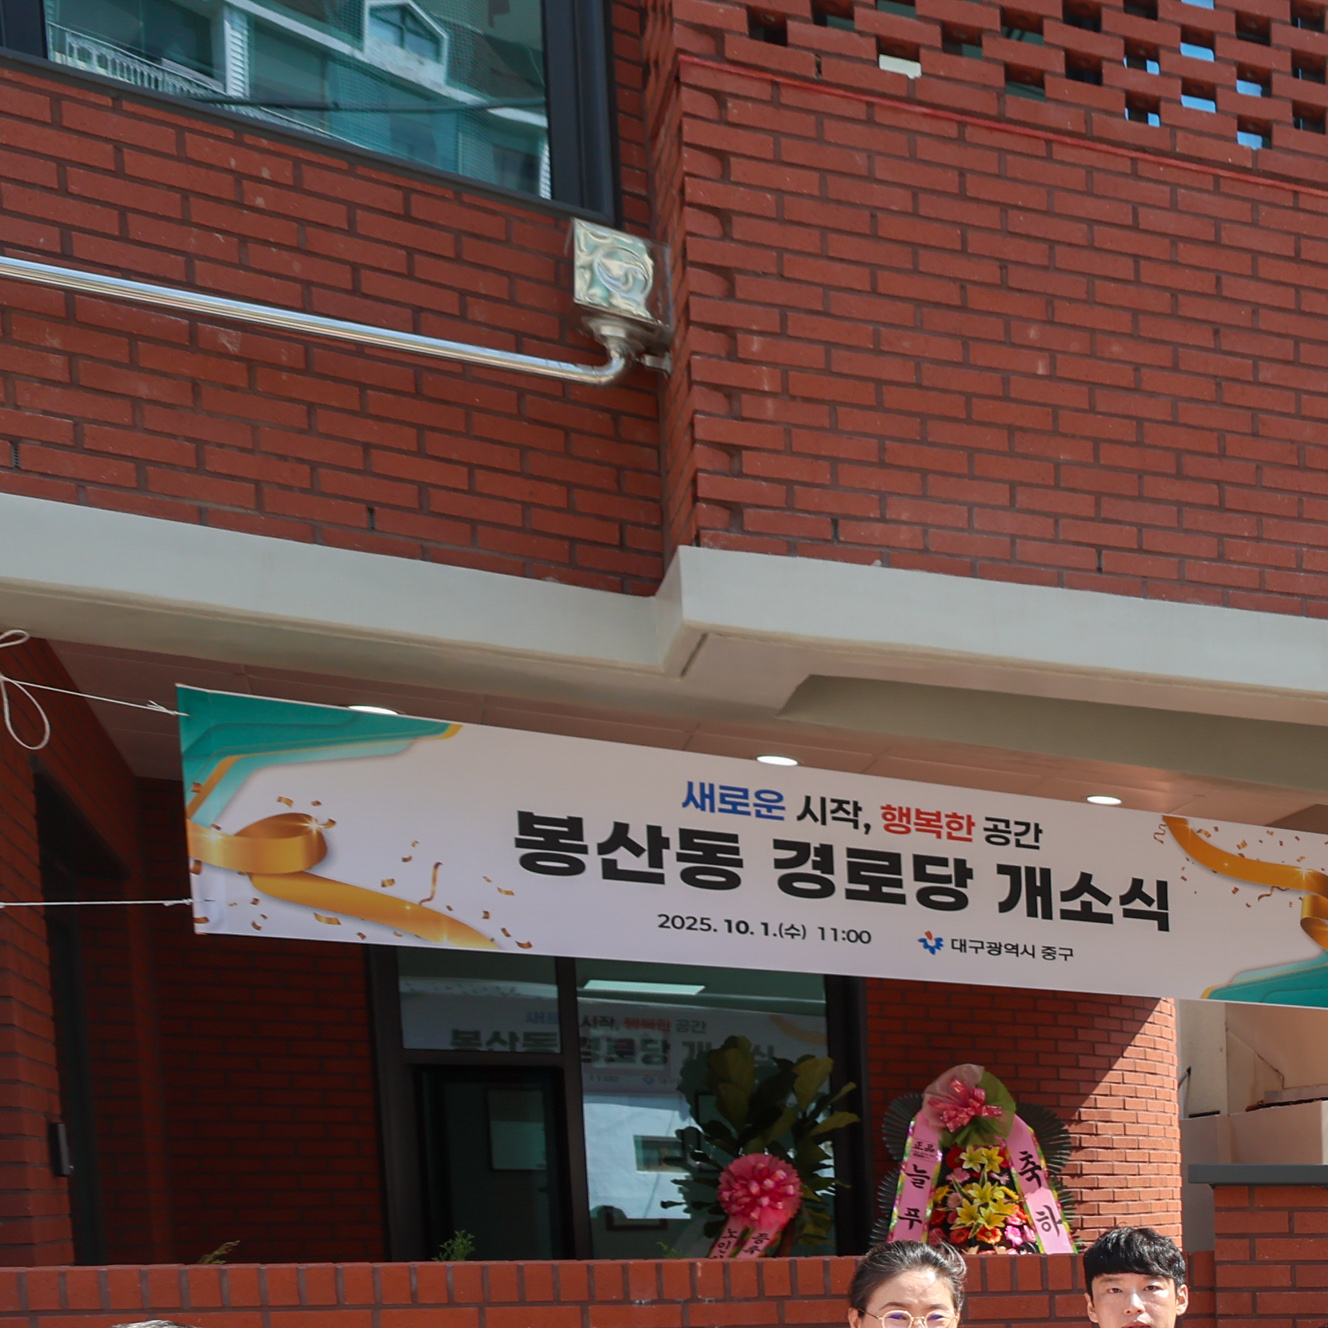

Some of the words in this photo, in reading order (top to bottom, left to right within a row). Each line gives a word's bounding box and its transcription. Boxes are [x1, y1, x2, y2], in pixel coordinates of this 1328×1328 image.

[682, 780, 786, 821] 새로운
[796, 795, 872, 834] 시작,
[880, 804, 976, 842] 행복한
[983, 816, 1043, 850] 공간
[514, 810, 744, 891] 봉산동
[772, 838, 974, 912] 경로당
[996, 863, 1170, 932] 개소식
[657, 913, 718, 932] 2025.
[724, 918, 754, 935] 10.
[760, 921, 807, 940] 1.(수)
[818, 926, 872, 944] 11:00
[951, 938, 1036, 959] 대구광역시
[1041, 946, 1074, 961] 중구
